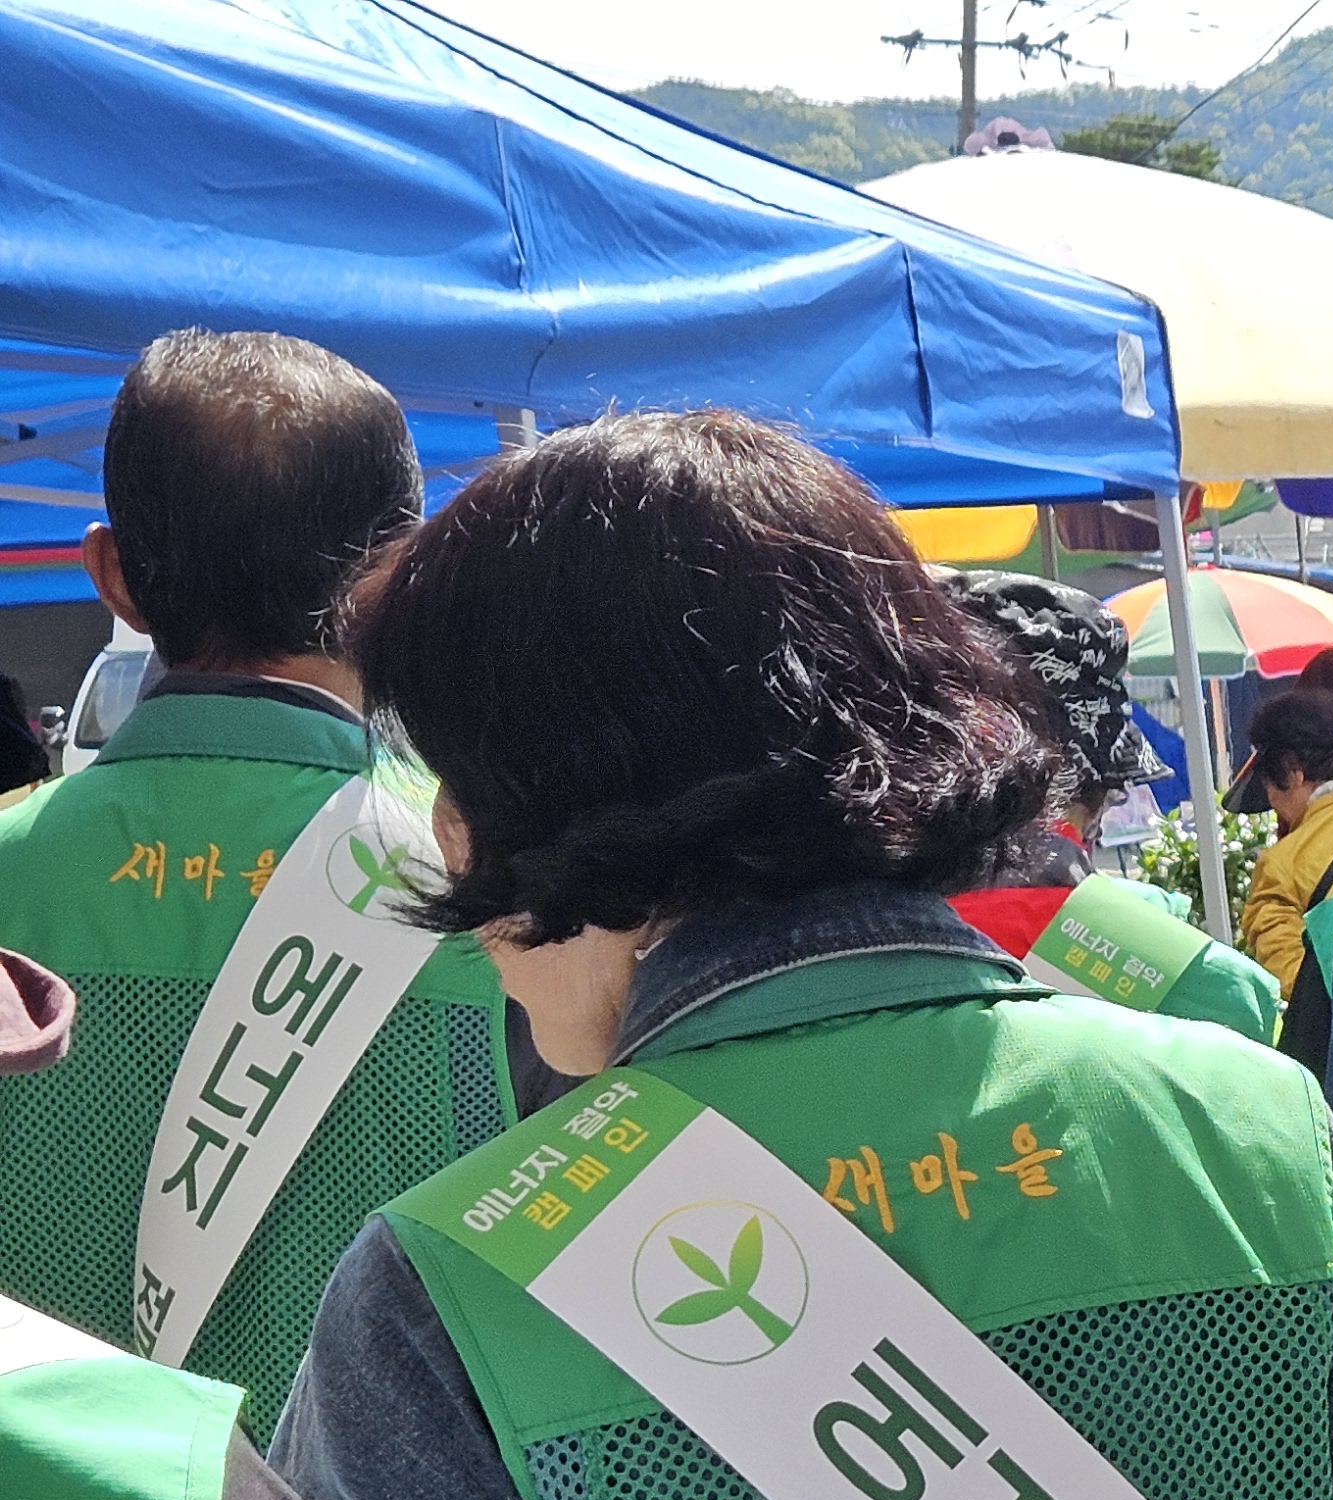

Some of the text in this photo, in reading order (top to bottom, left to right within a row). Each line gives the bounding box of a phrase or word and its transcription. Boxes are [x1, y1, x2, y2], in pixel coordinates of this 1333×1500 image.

[1061, 917, 1120, 961] 에너지
[161, 935, 363, 1230] 에너지
[462, 1081, 639, 1232] 에너지 절약
[822, 1122, 1063, 1234] 새마을
